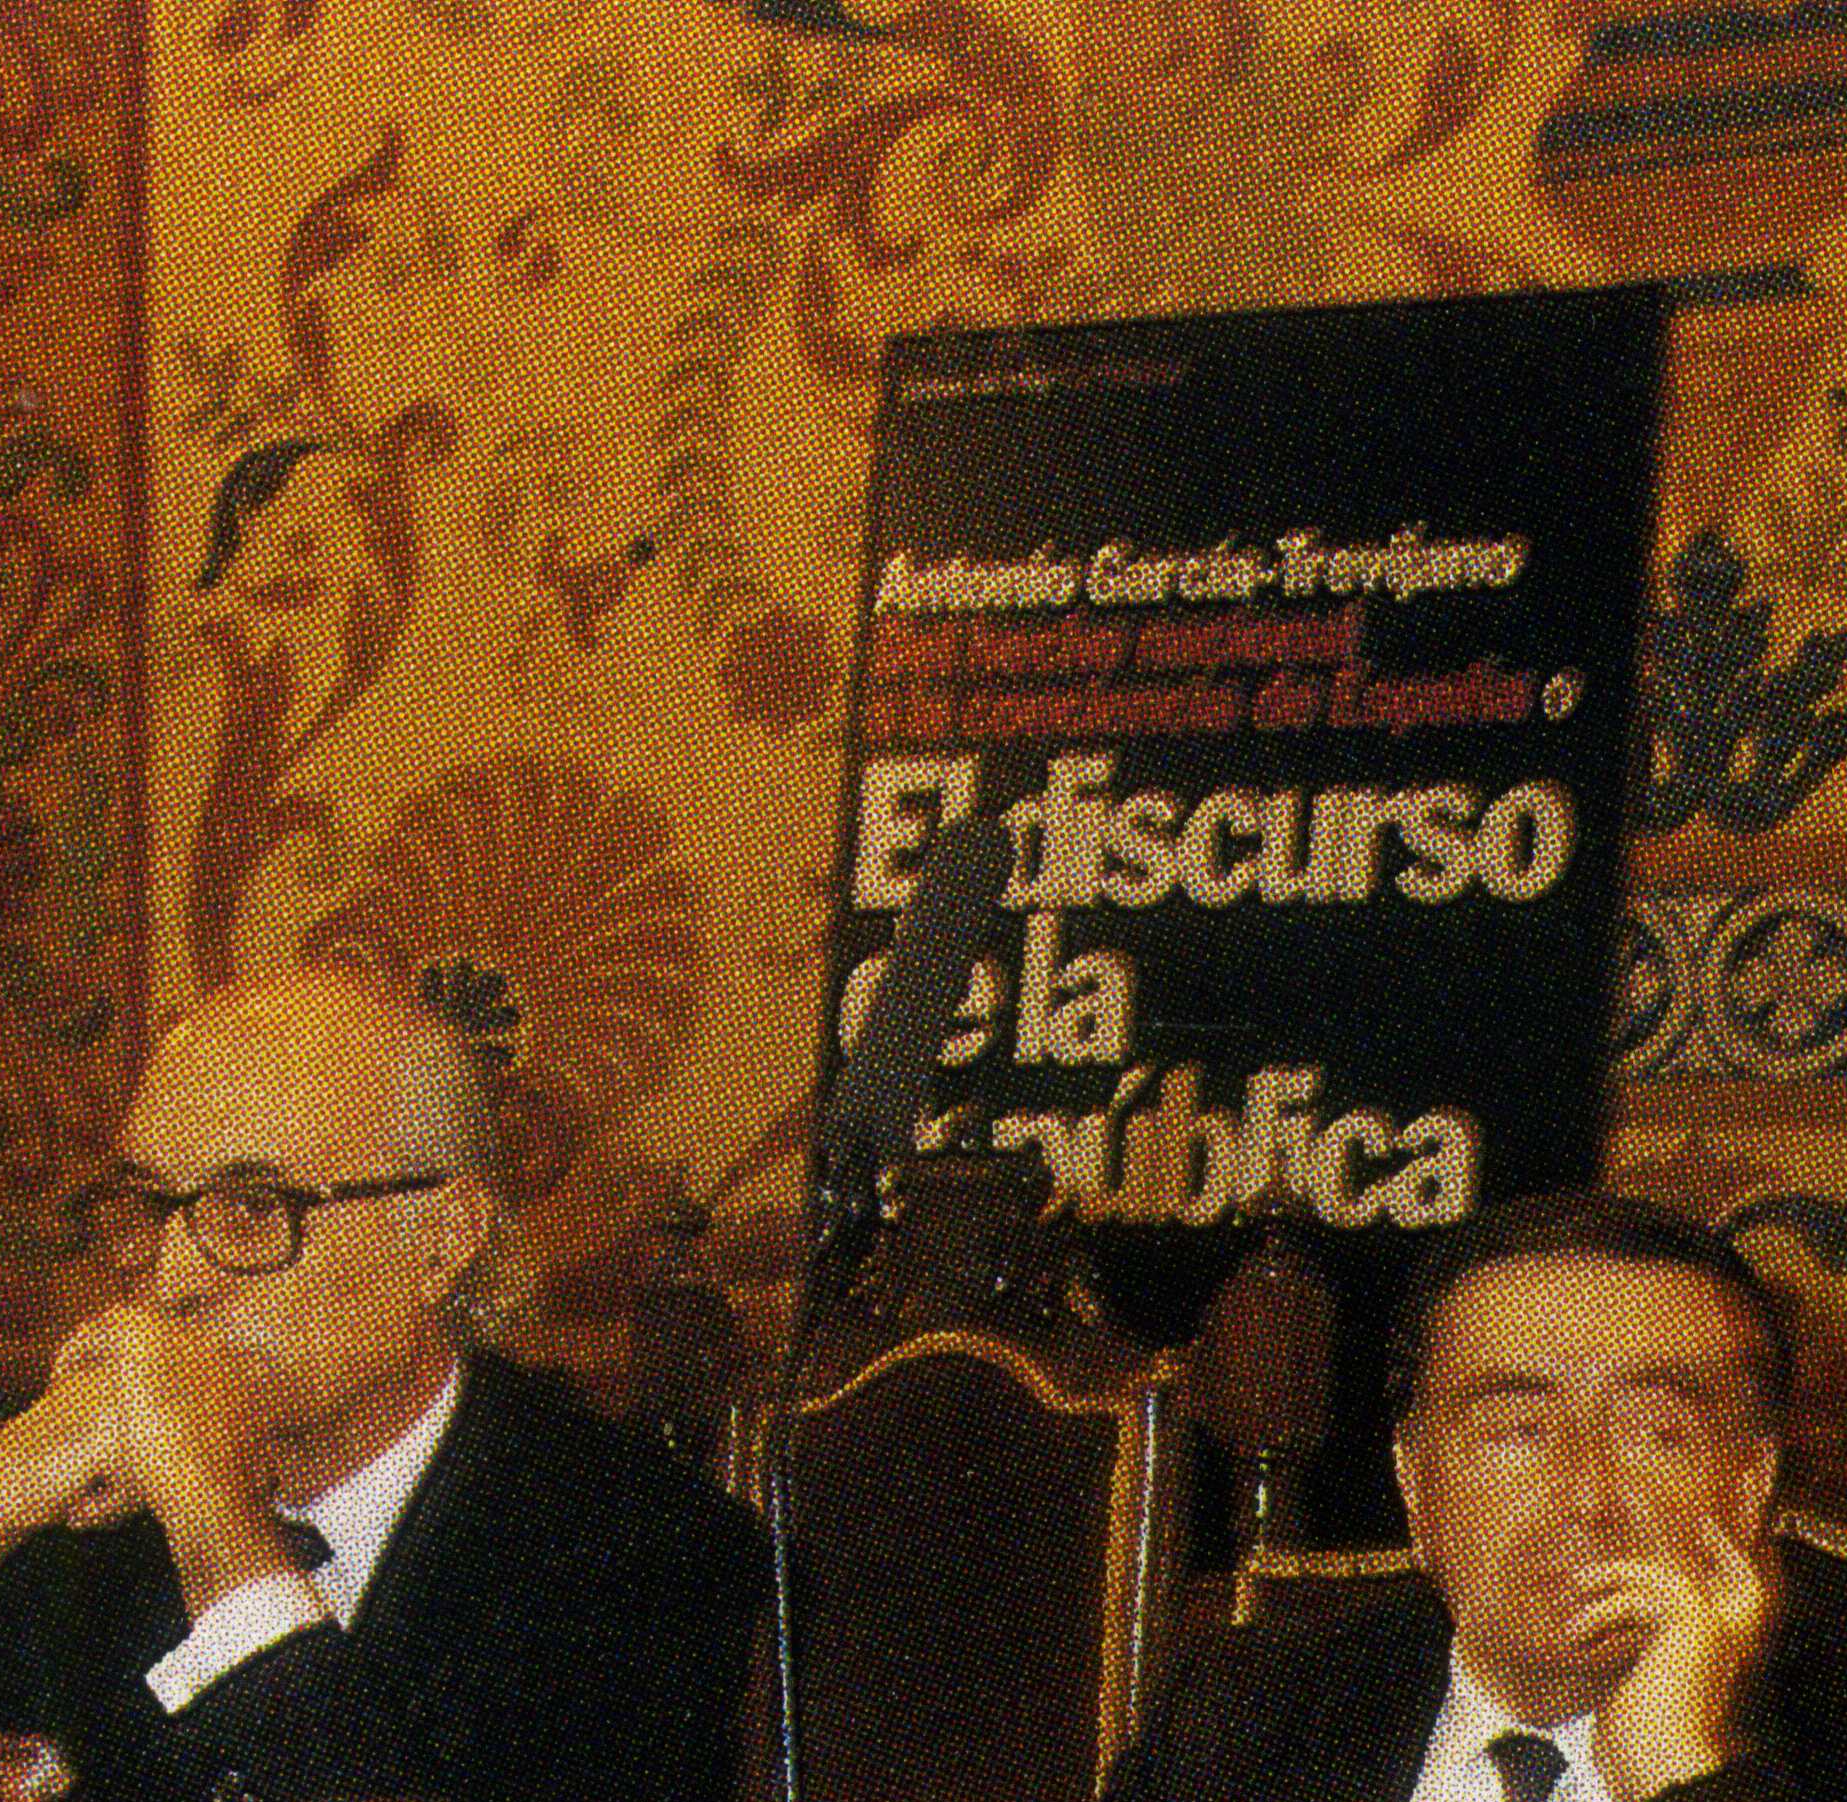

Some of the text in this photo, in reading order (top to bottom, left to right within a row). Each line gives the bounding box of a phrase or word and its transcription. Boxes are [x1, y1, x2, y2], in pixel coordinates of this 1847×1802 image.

[876, 523, 1526, 613] Antonio García-Trevijano
[965, 612, 1123, 676] hecho
[1137, 603, 1364, 669] nacional
[903, 682, 953, 740] la
[961, 679, 1243, 738] conciencia
[1252, 668, 1319, 729] de
[1330, 658, 1530, 736] España
[1001, 752, 1573, 908] discurso
[1015, 912, 1137, 1064] la
